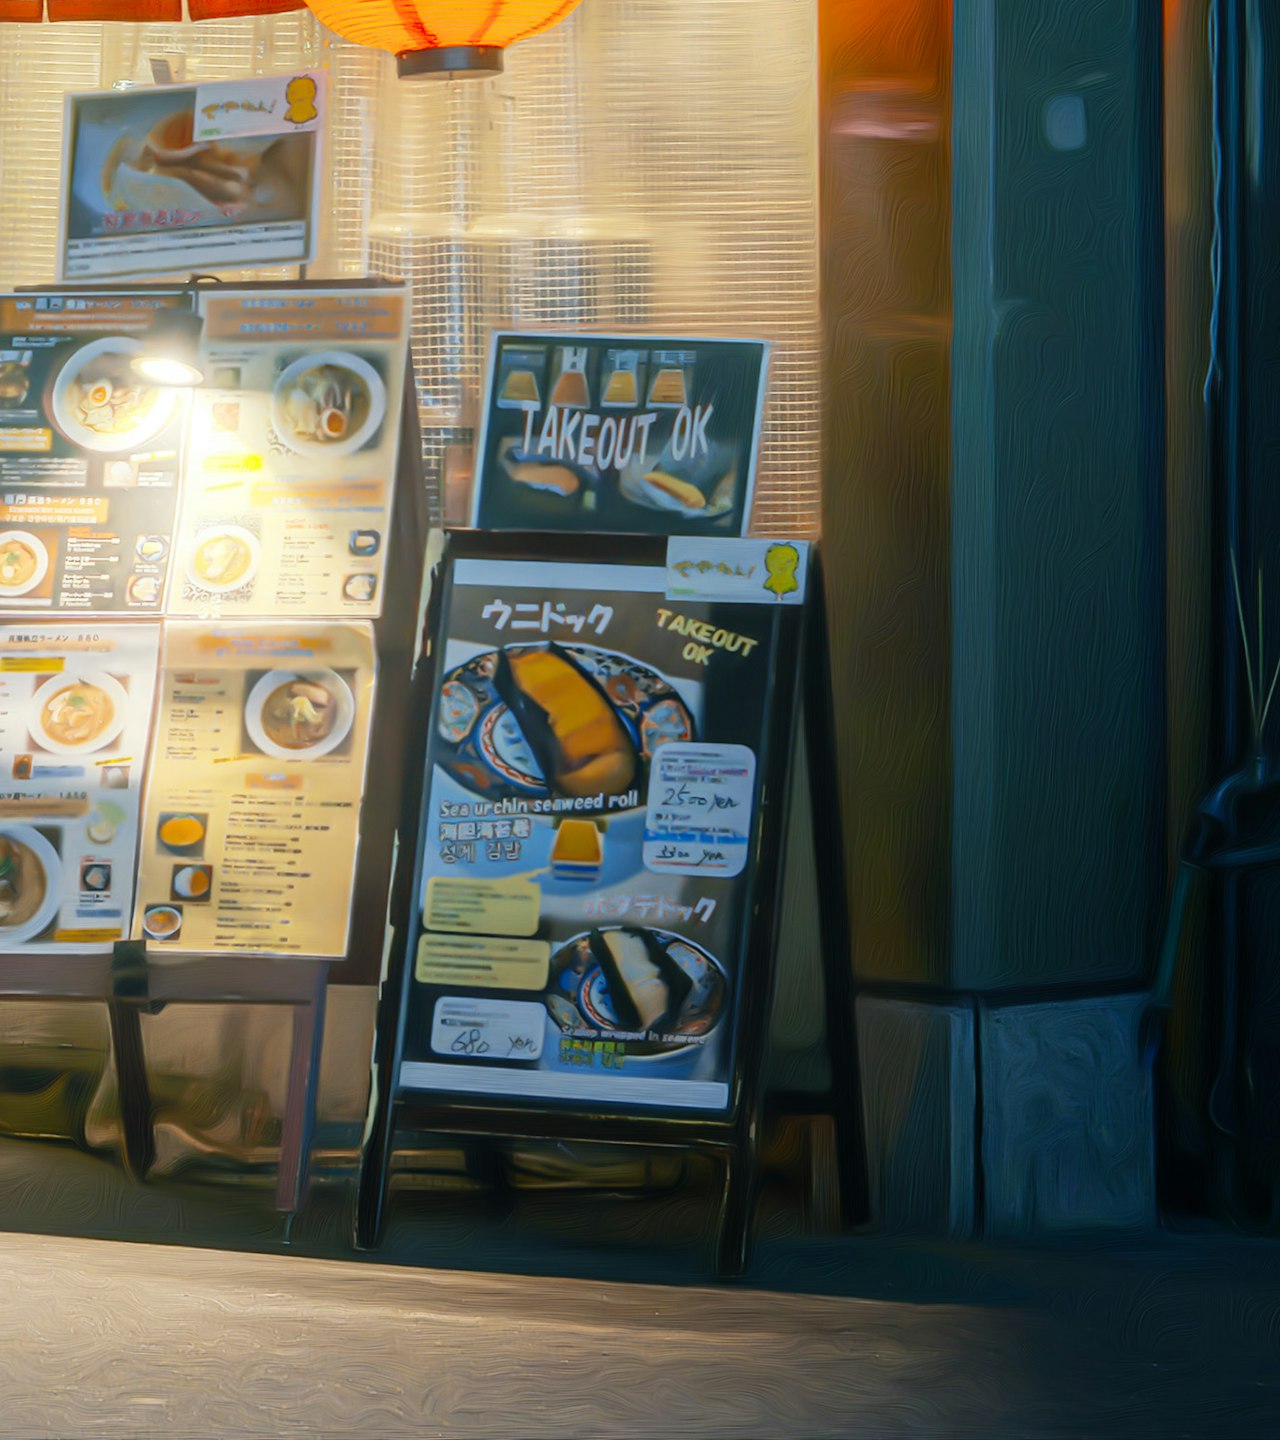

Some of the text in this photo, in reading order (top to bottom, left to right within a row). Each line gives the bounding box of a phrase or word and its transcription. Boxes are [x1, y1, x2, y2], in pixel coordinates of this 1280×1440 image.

[521, 400, 715, 471] TAKEOUT OK
[481, 598, 614, 635] ウニドック
[656, 607, 758, 659] TAKEOUT
[682, 642, 715, 666] OK
[439, 790, 639, 818] Sea urchin seaweed roll
[661, 784, 739, 813] 2500 yen
[450, 1028, 491, 1054] 680
